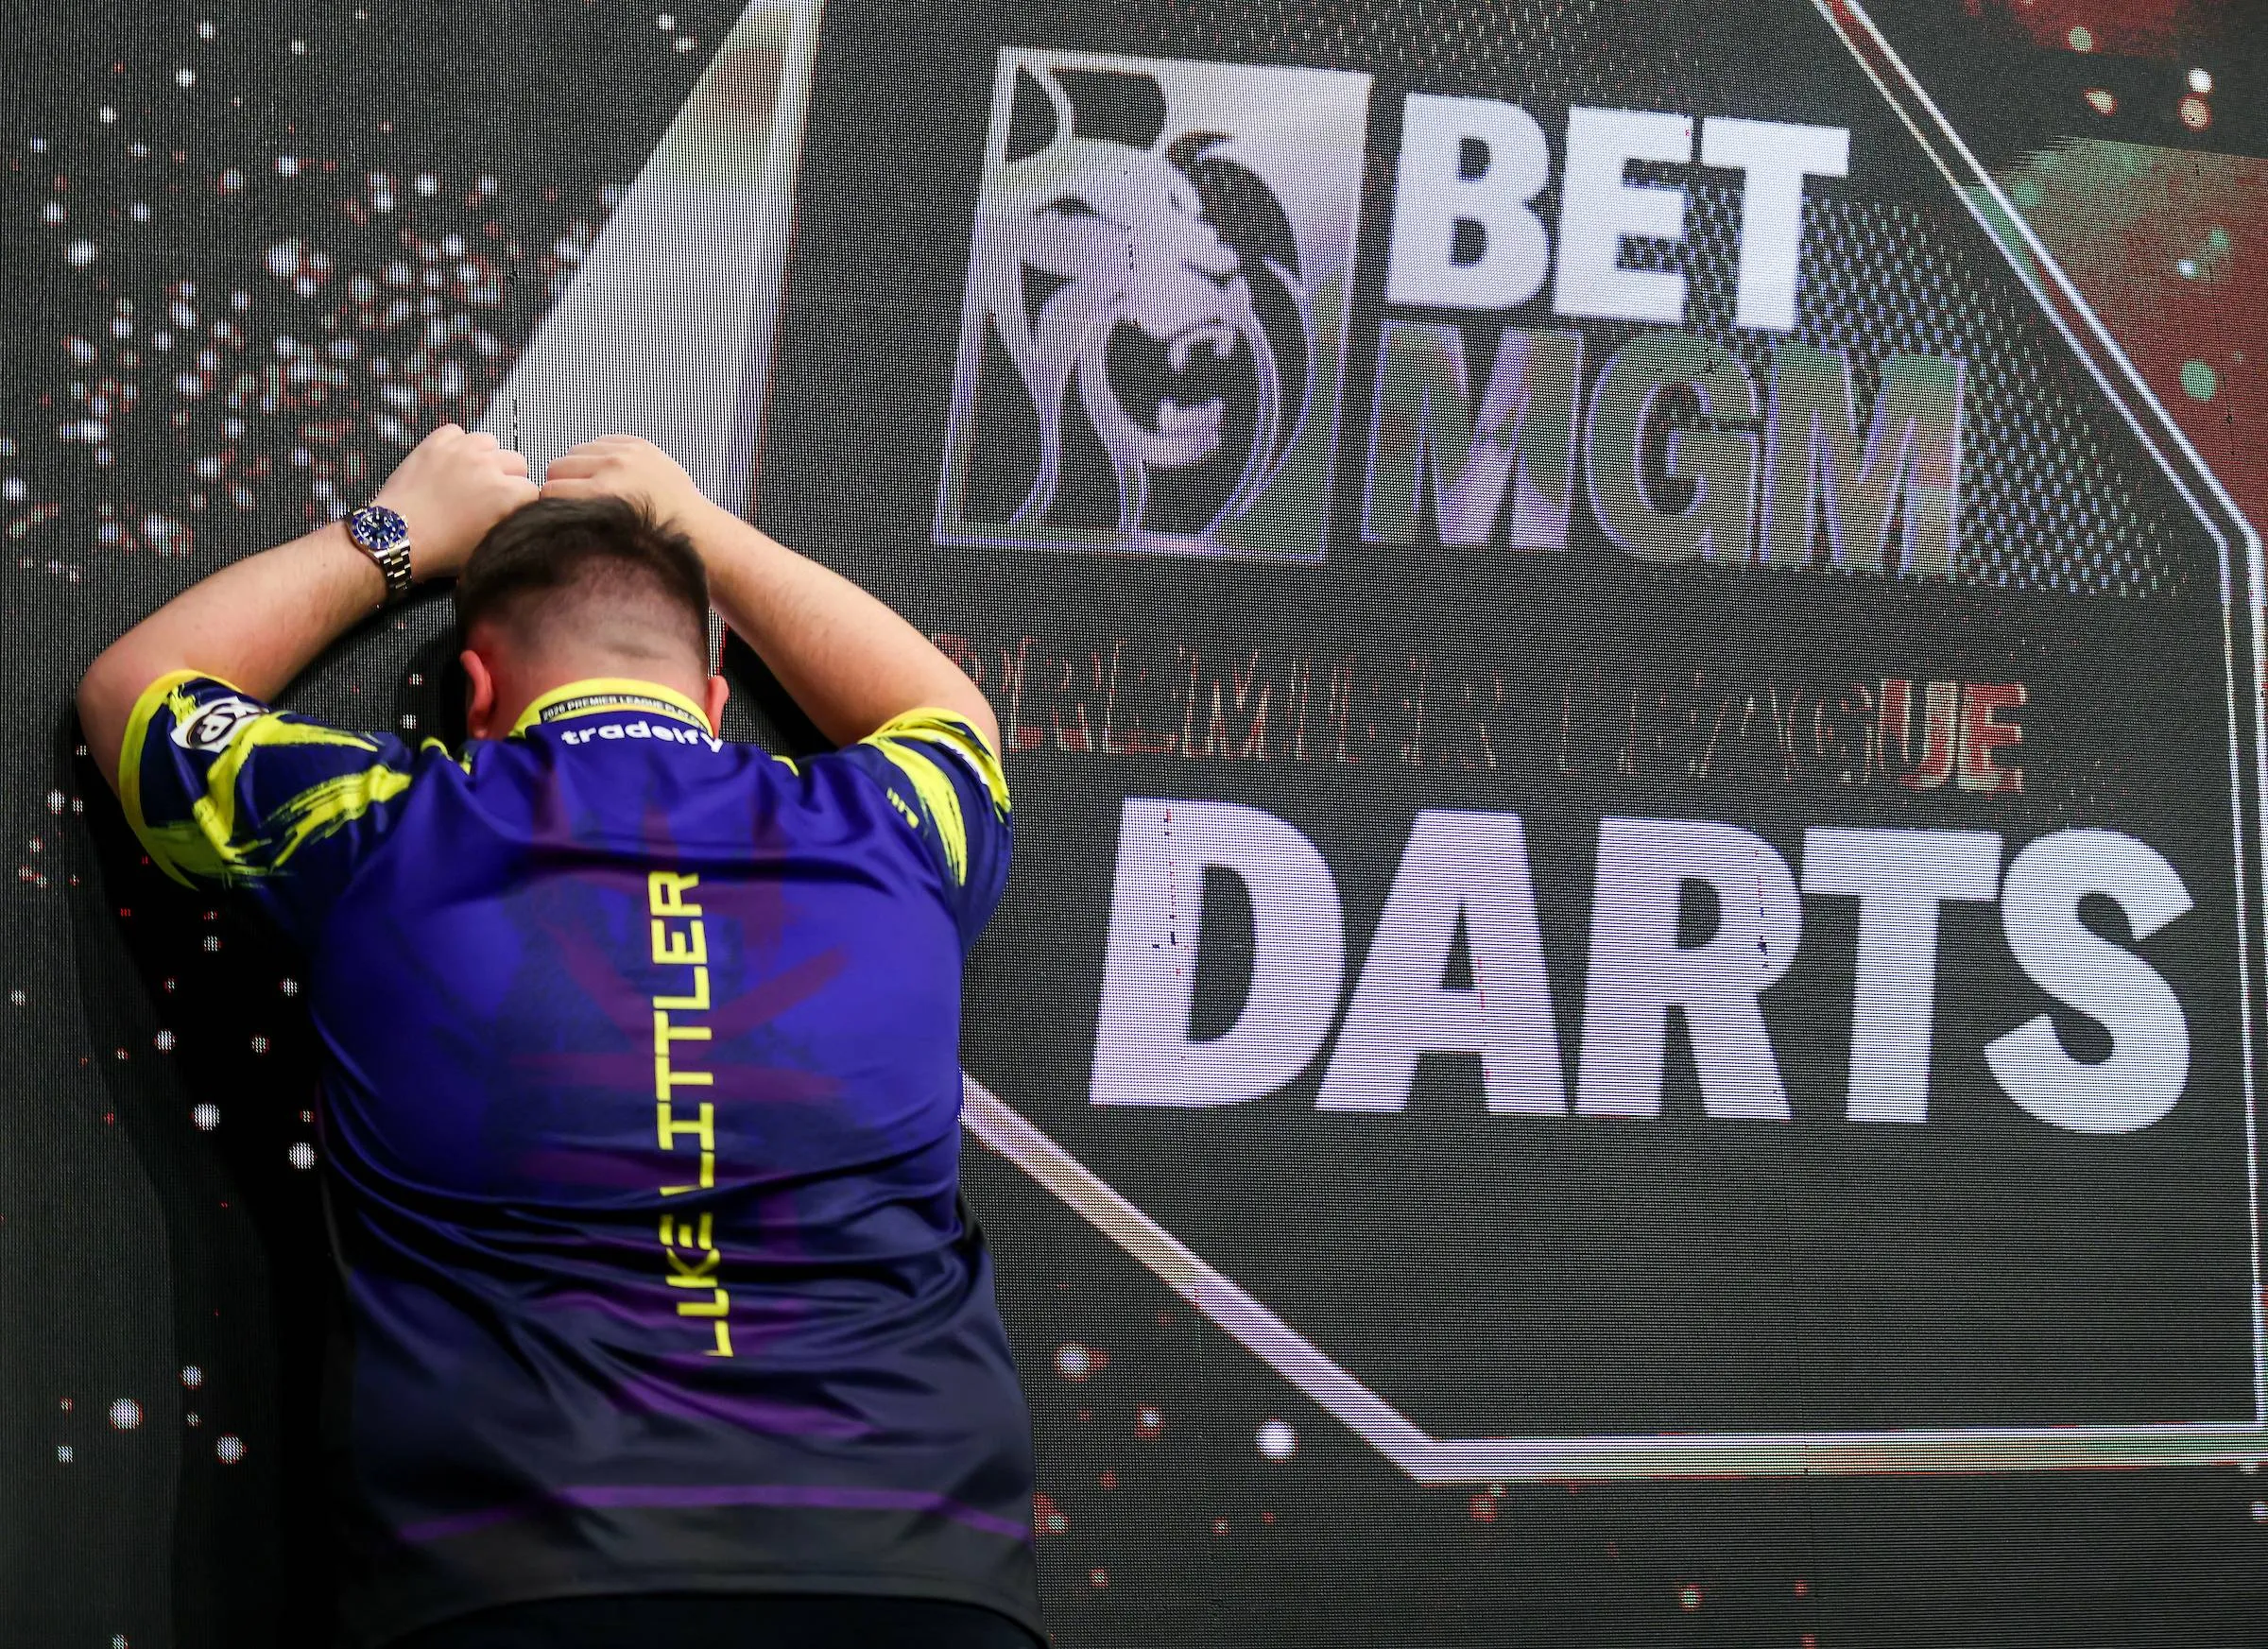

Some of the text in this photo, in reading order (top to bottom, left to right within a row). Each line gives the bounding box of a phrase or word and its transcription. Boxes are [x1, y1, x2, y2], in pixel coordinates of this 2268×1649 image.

[1387, 92, 1849, 333] BET
[1360, 318, 1968, 576] MGM
[567, 696, 617, 711] PREMIER
[1089, 796, 2195, 1135] DARTS
[648, 870, 733, 1358] LUKE LITTLER
